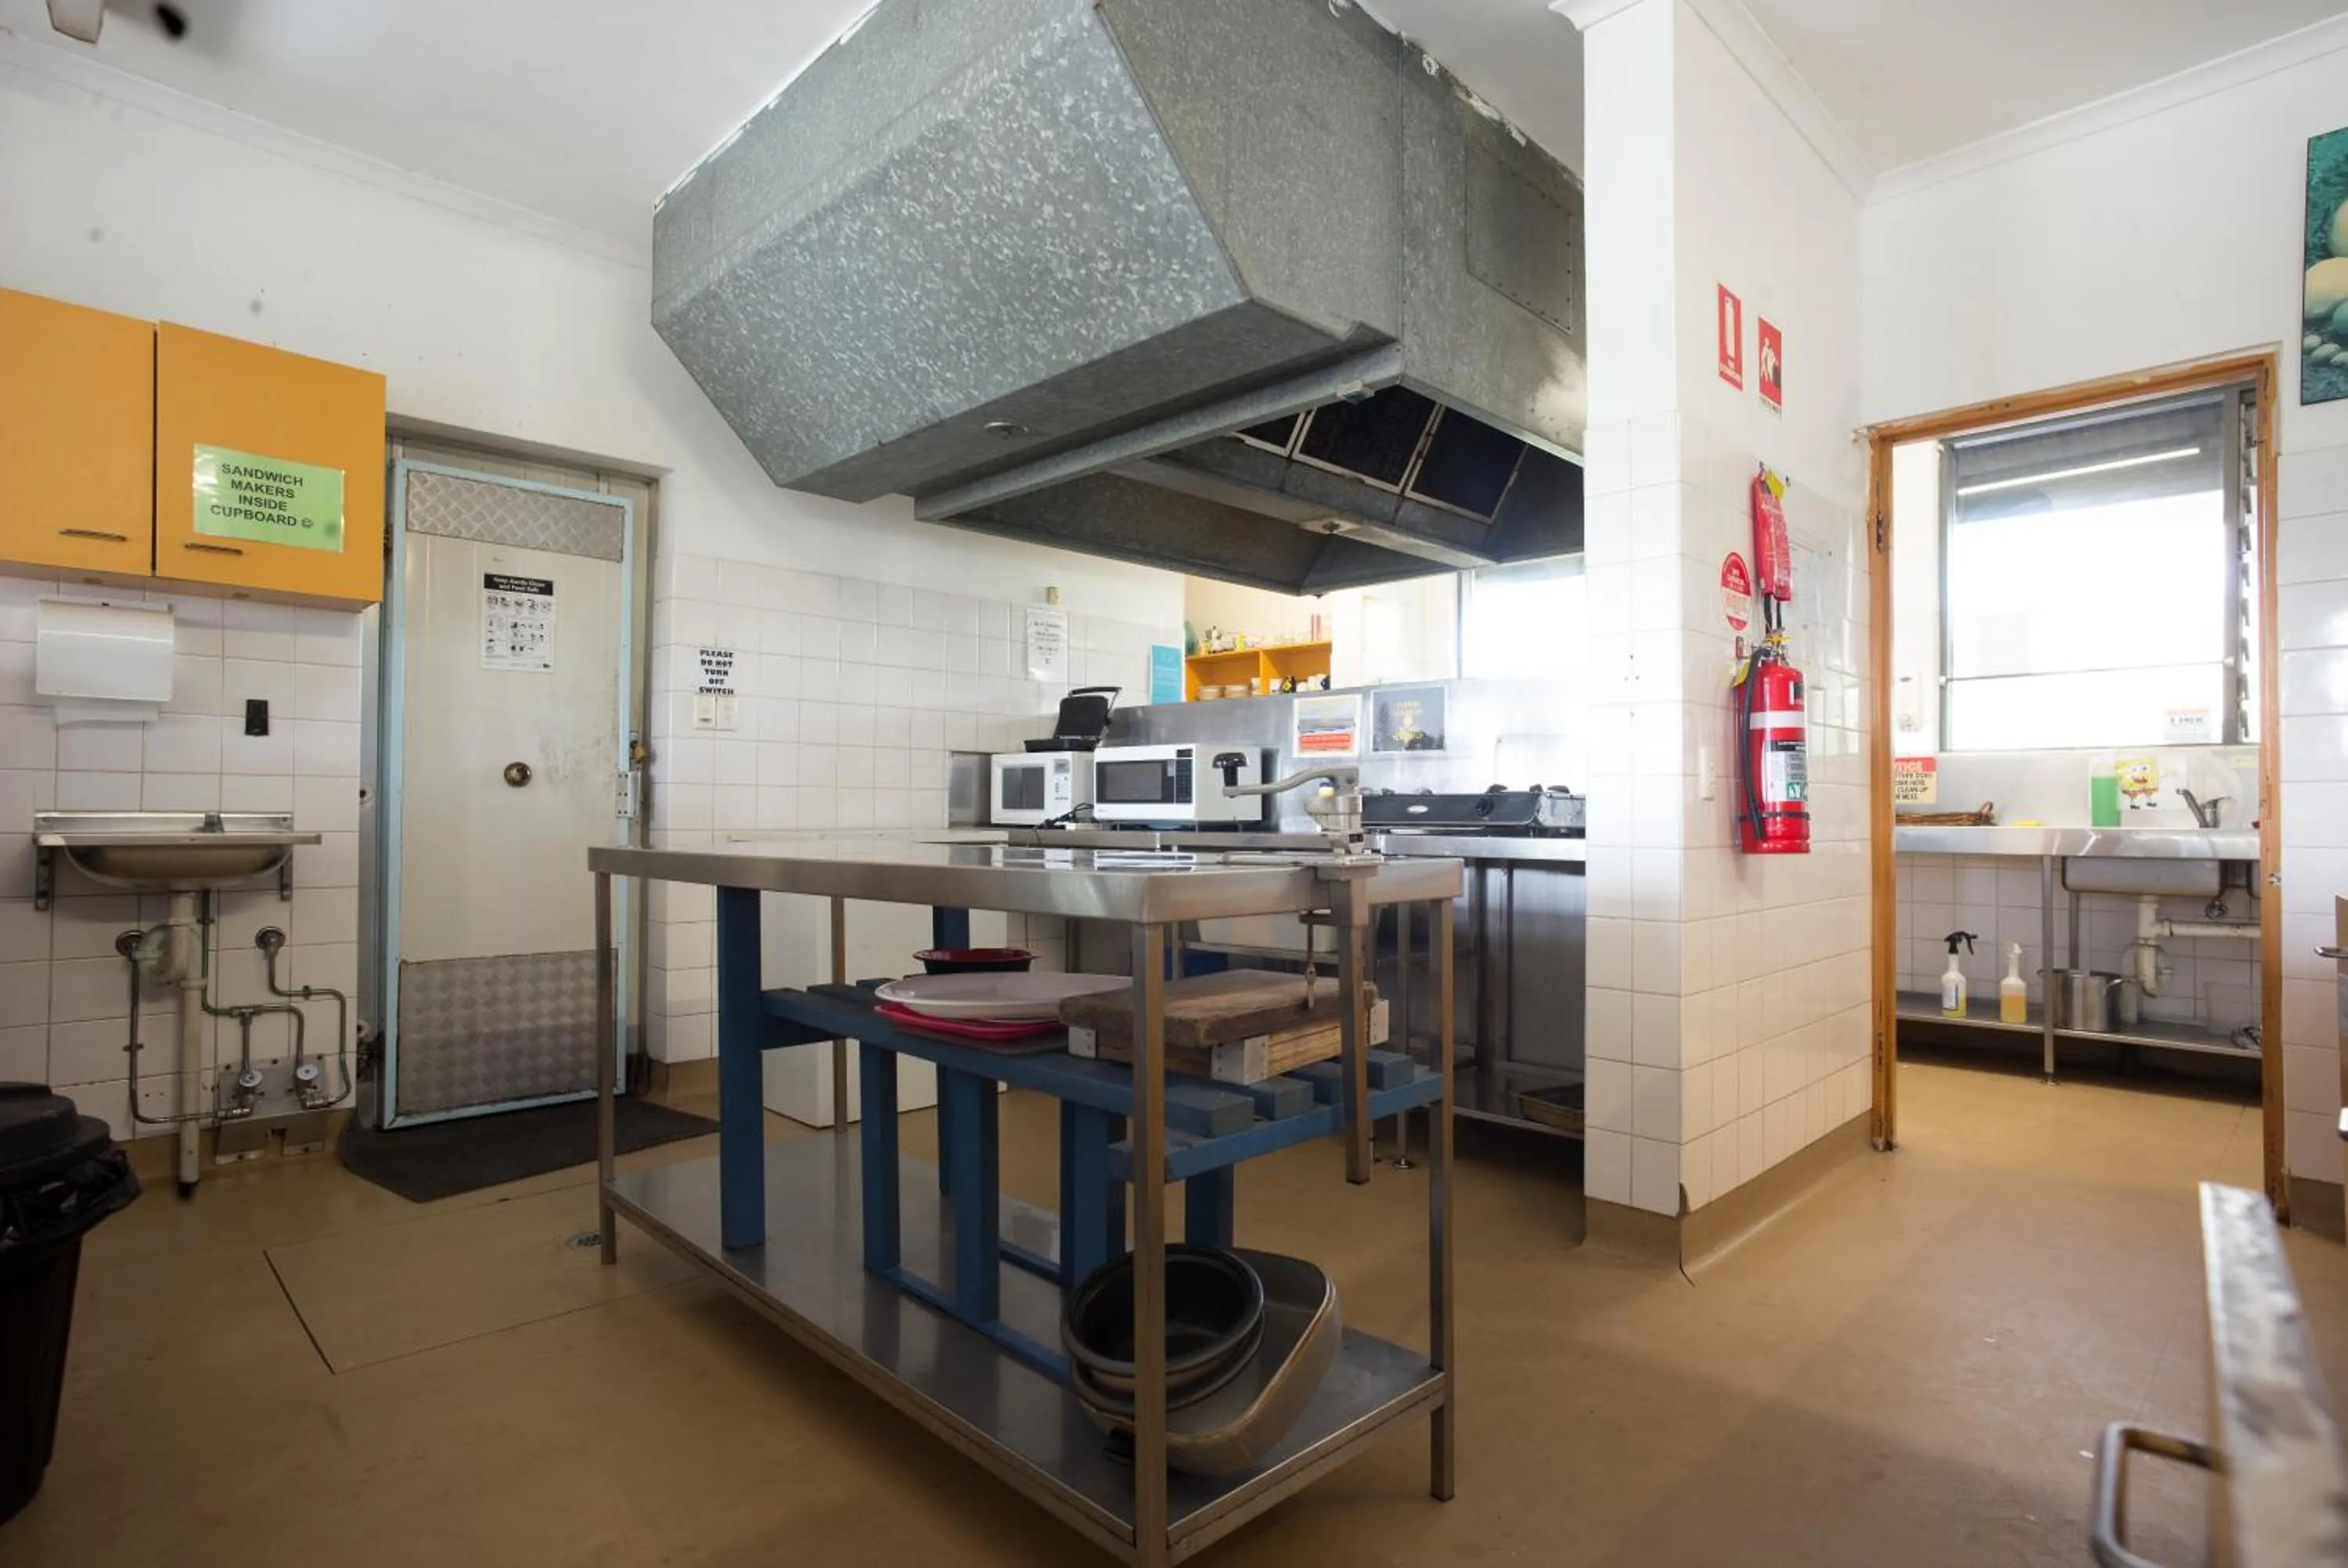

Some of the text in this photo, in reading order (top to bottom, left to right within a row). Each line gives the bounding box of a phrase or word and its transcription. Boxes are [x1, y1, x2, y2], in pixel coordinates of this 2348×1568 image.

[221, 463, 304, 487] SANDWICH
[230, 478, 295, 498] MAKERS
[238, 494, 287, 511] INSIDE
[210, 505, 297, 527] CUPBOARD
[699, 649, 733, 658] PLEASE
